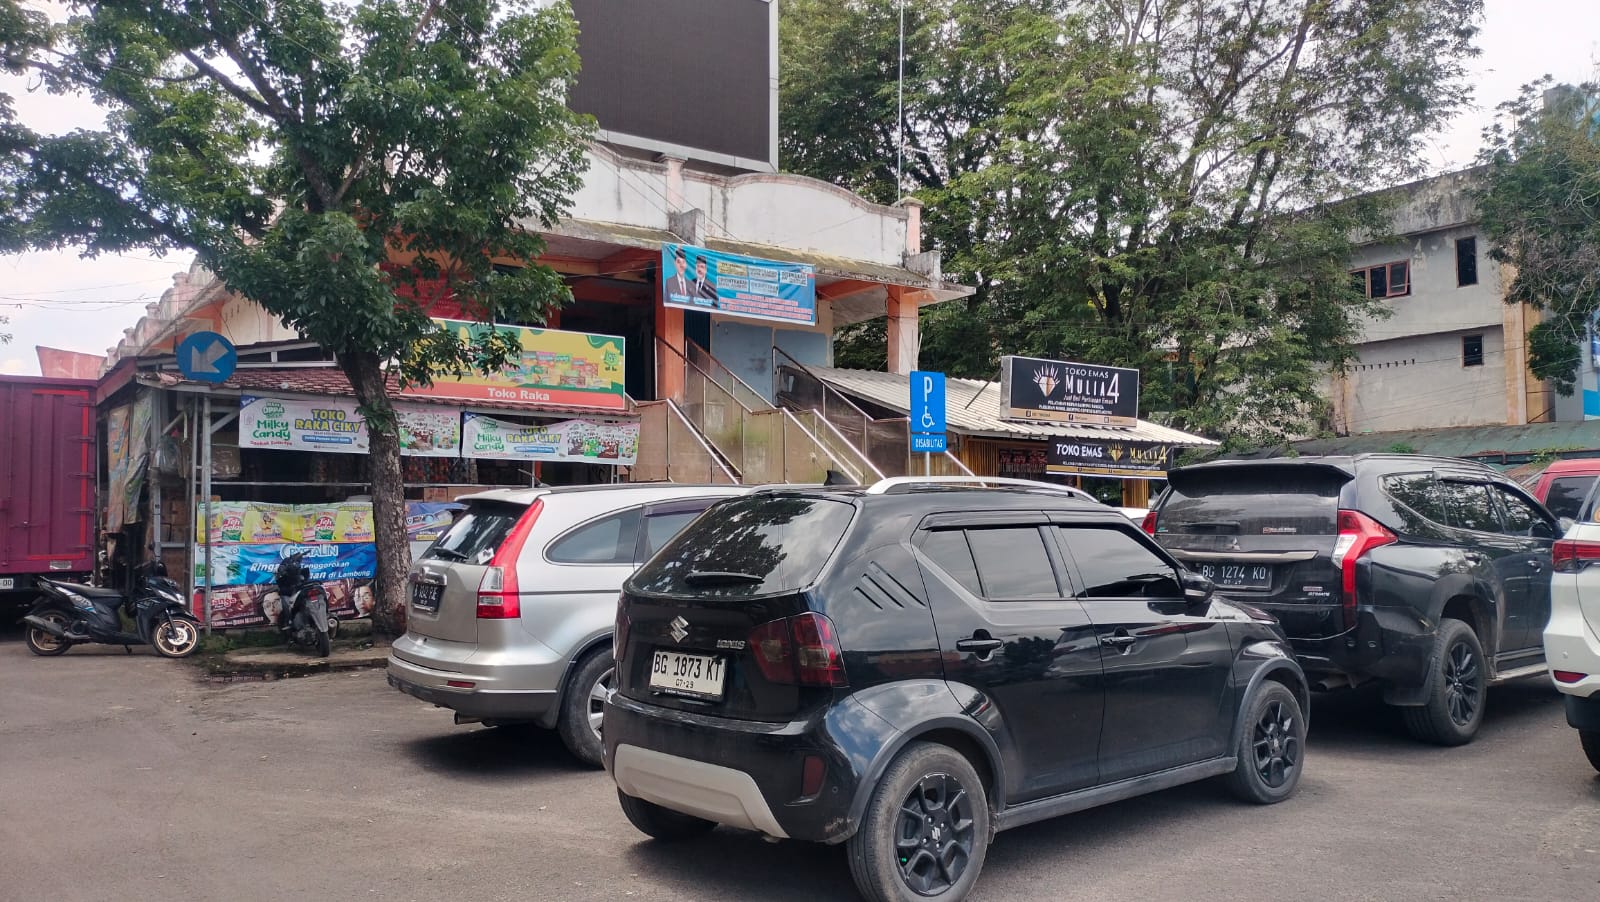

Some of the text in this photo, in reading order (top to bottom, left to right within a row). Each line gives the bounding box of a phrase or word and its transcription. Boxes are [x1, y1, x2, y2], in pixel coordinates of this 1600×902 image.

[1064, 367, 1109, 379] TOKO EMAS
[487, 387, 550, 401] Toko Raka
[923, 376, 933, 402] P
[1065, 372, 1120, 404] MULIA 4
[311, 408, 346, 420] TOKO
[256, 419, 289, 431] Milky
[294, 418, 361, 433] RAKA CIKY
[252, 429, 291, 441] Candy
[476, 433, 502, 443] Milky
[506, 433, 536, 444] RAKA
[473, 442, 505, 452] Candy
[915, 438, 943, 448] DISABILITAS
[1056, 443, 1080, 456] TOKO
[1081, 445, 1103, 458] EMAS
[1157, 445, 1168, 464] 4
[327, 571, 336, 579] di
[337, 570, 372, 578] Lambung
[1202, 564, 1216, 578] BG
[1221, 565, 1246, 579] 1274
[653, 653, 722, 682] BG 1873 KT
